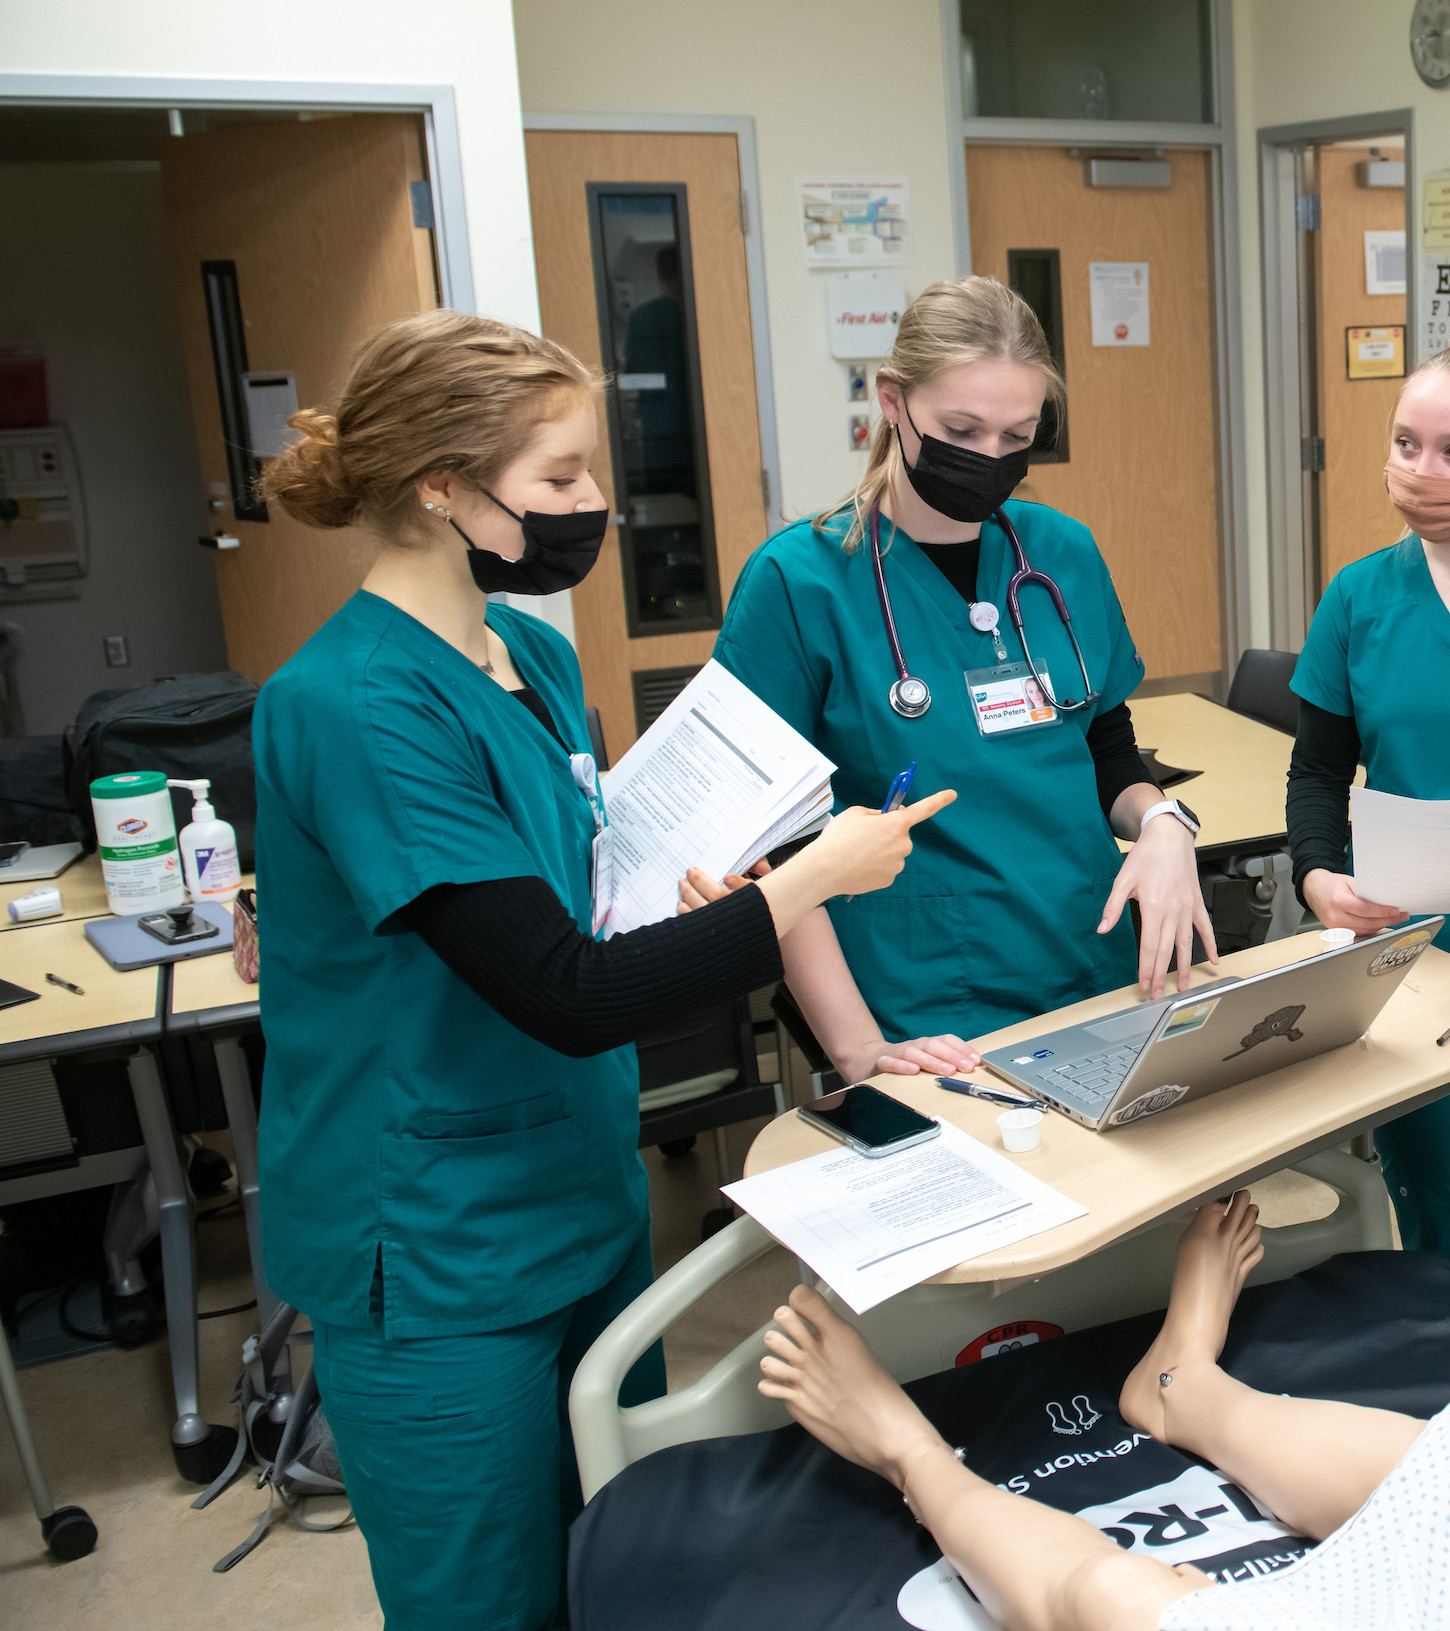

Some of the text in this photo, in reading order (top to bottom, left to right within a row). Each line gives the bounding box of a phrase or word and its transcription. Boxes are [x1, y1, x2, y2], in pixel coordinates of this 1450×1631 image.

[842, 312, 887, 324] First Aid
[983, 707, 1026, 721] Anna Peters
[1370, 942, 1428, 968] OREGON
[986, 1323, 1029, 1344] CPR
